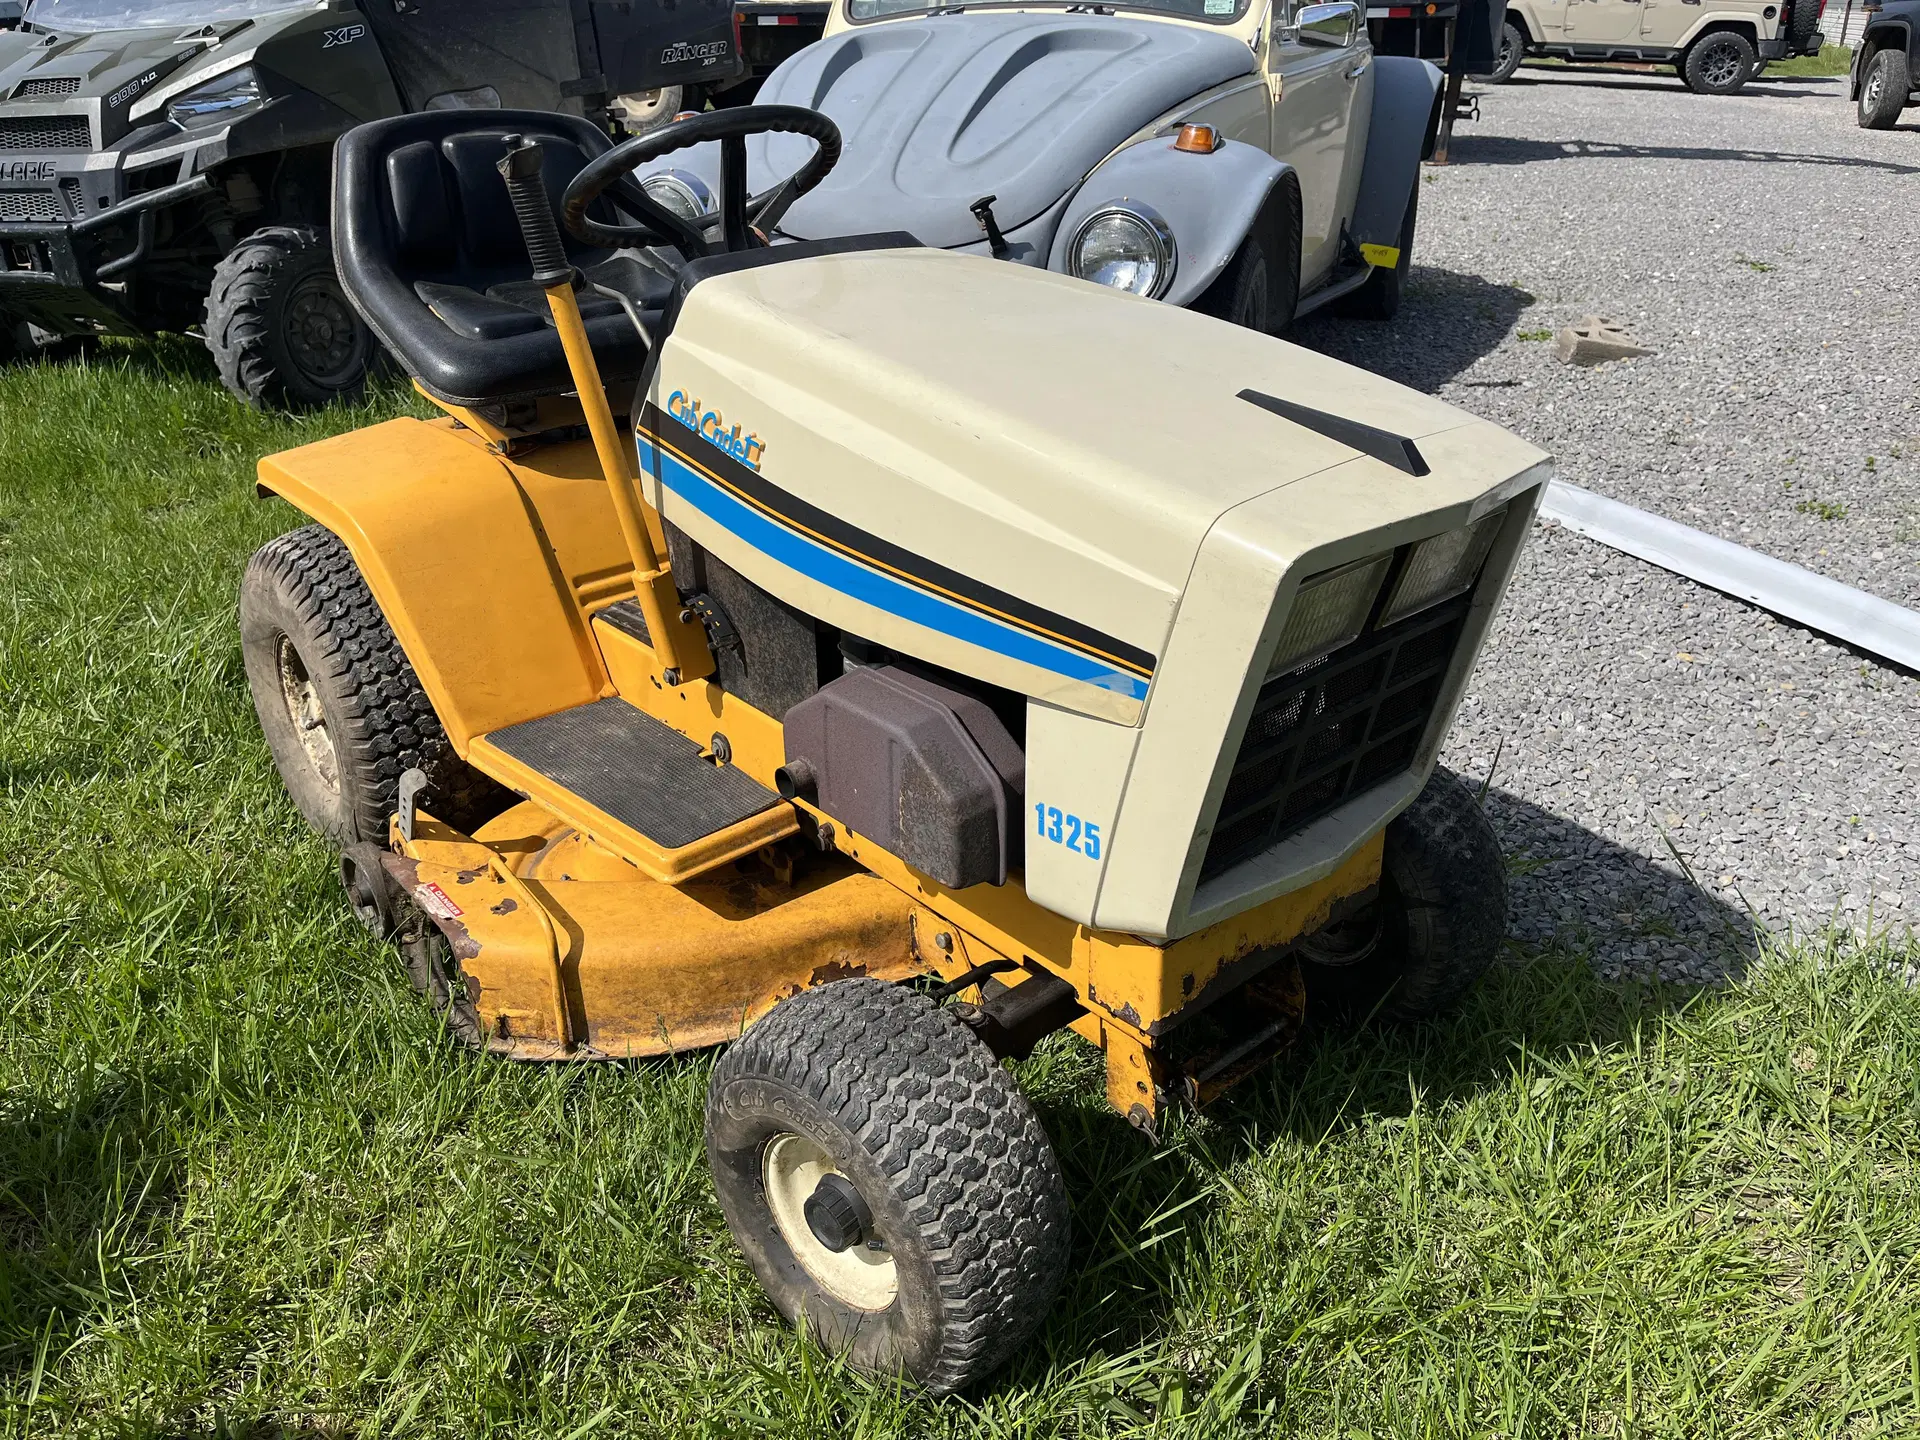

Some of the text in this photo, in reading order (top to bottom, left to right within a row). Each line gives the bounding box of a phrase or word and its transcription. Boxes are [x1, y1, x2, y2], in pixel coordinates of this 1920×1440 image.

[322, 24, 365, 48] XP
[661, 40, 728, 64] RANGER
[702, 57, 716, 66] XP
[109, 80, 140, 108] 900
[667, 388, 766, 473] Cub Cadet
[1035, 802, 1100, 860] 1325
[435, 889, 461, 915] DANGER
[739, 1087, 830, 1144] Cub Cadet
